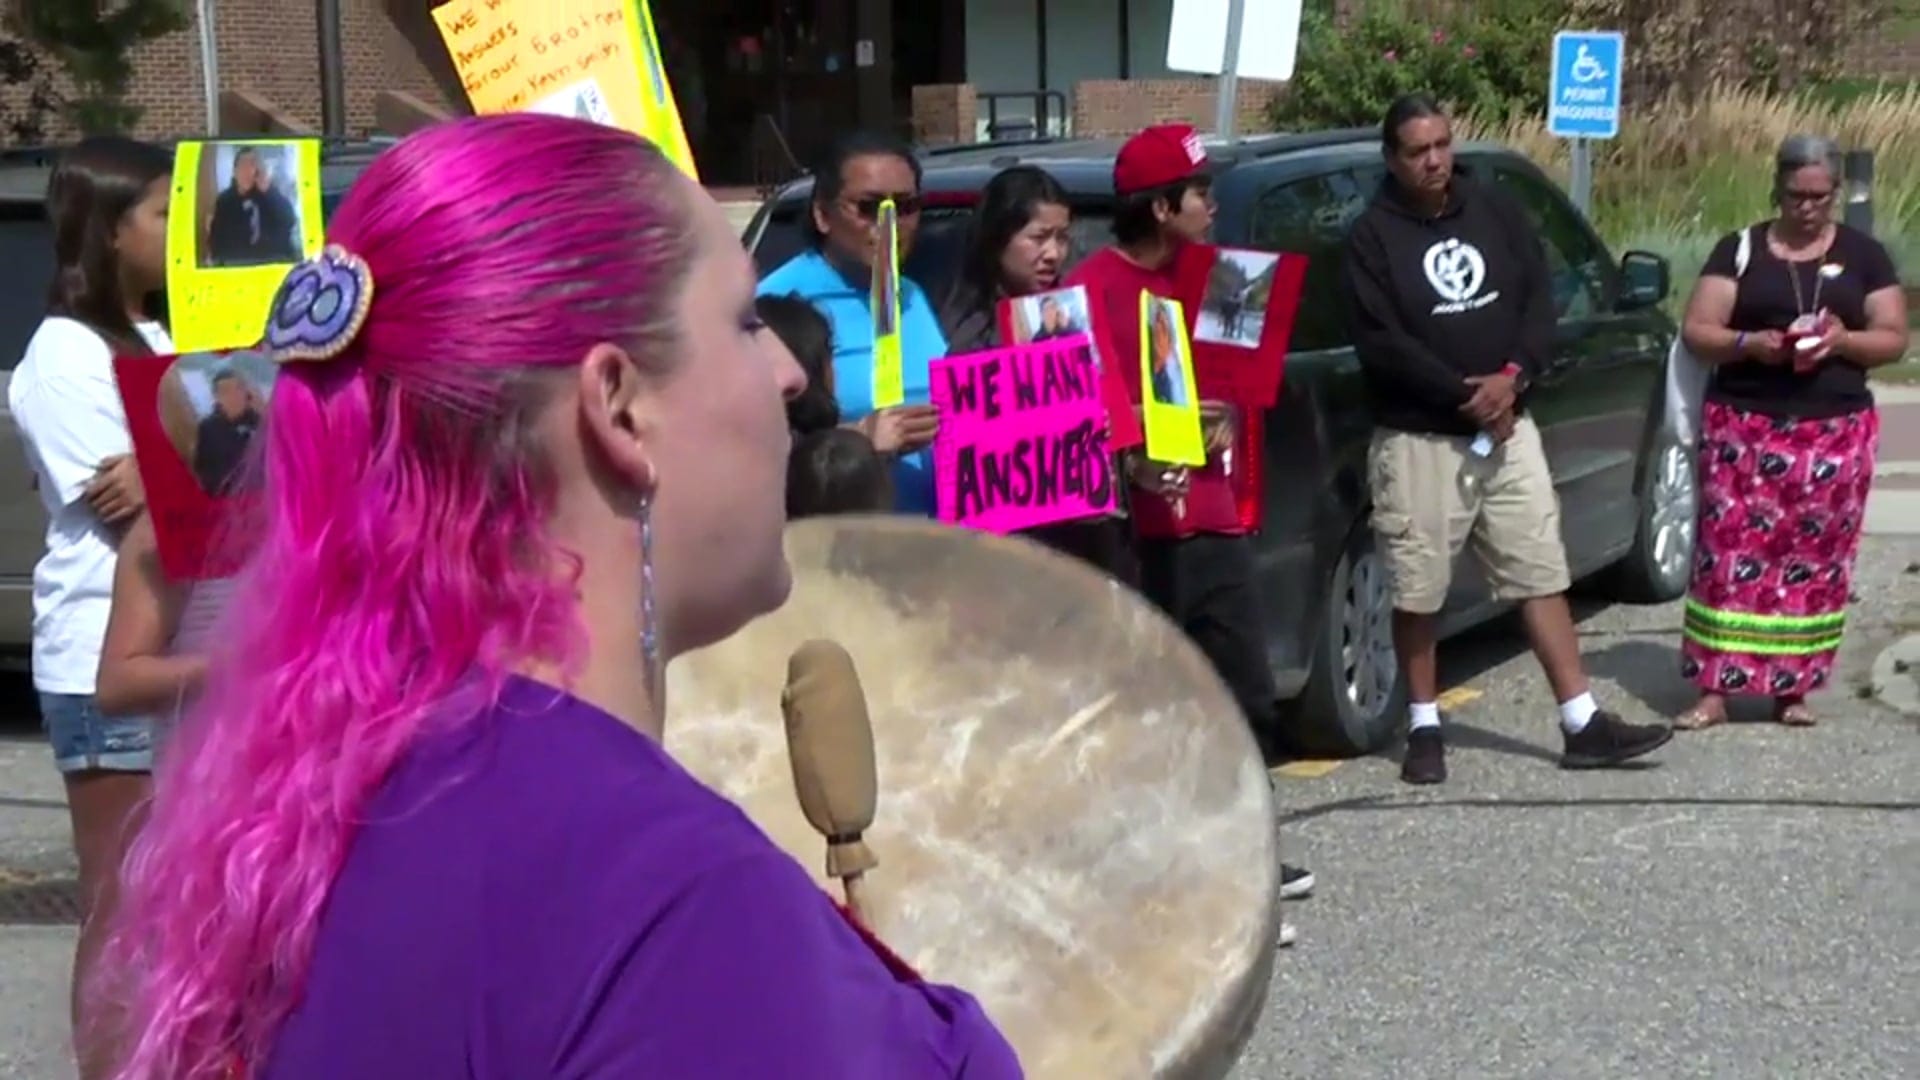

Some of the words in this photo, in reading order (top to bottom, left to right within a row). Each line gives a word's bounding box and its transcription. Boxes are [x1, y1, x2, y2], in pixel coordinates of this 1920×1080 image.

[445, 10, 478, 35] WE
[1563, 87, 1608, 102] PERMIT
[1554, 104, 1615, 120] REQUIRED
[947, 358, 1001, 421] WE
[1010, 345, 1096, 411] WANT
[955, 418, 1111, 521] ANSWERS
